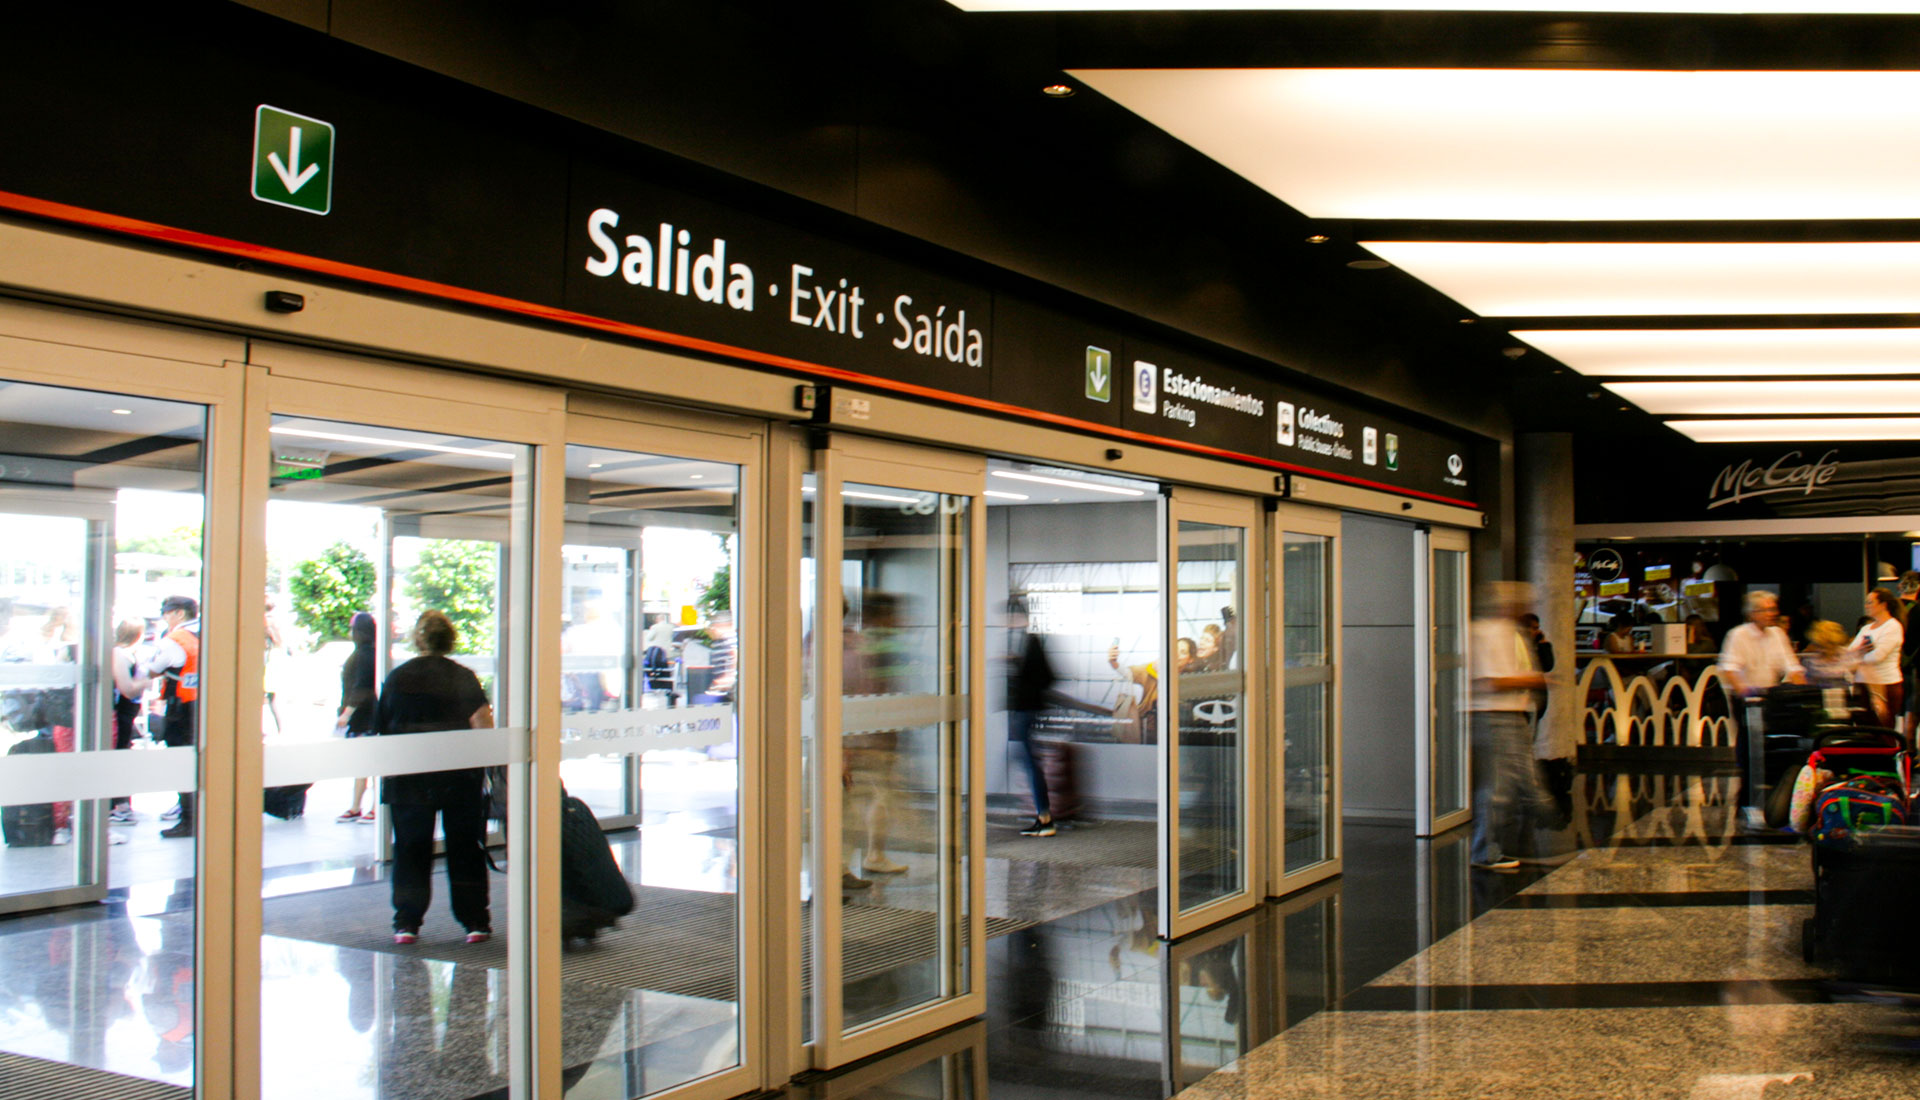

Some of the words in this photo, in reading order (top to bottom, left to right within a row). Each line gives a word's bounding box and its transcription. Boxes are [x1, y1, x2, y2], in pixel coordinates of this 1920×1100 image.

[584, 207, 755, 312] Salida
[790, 263, 865, 339] Exit
[892, 294, 984, 369] Saída
[1163, 367, 1264, 417] Estacionamientos
[1163, 399, 1196, 428] Parking
[1298, 406, 1344, 438] Colectivos
[1707, 448, 1840, 506] McCafé
